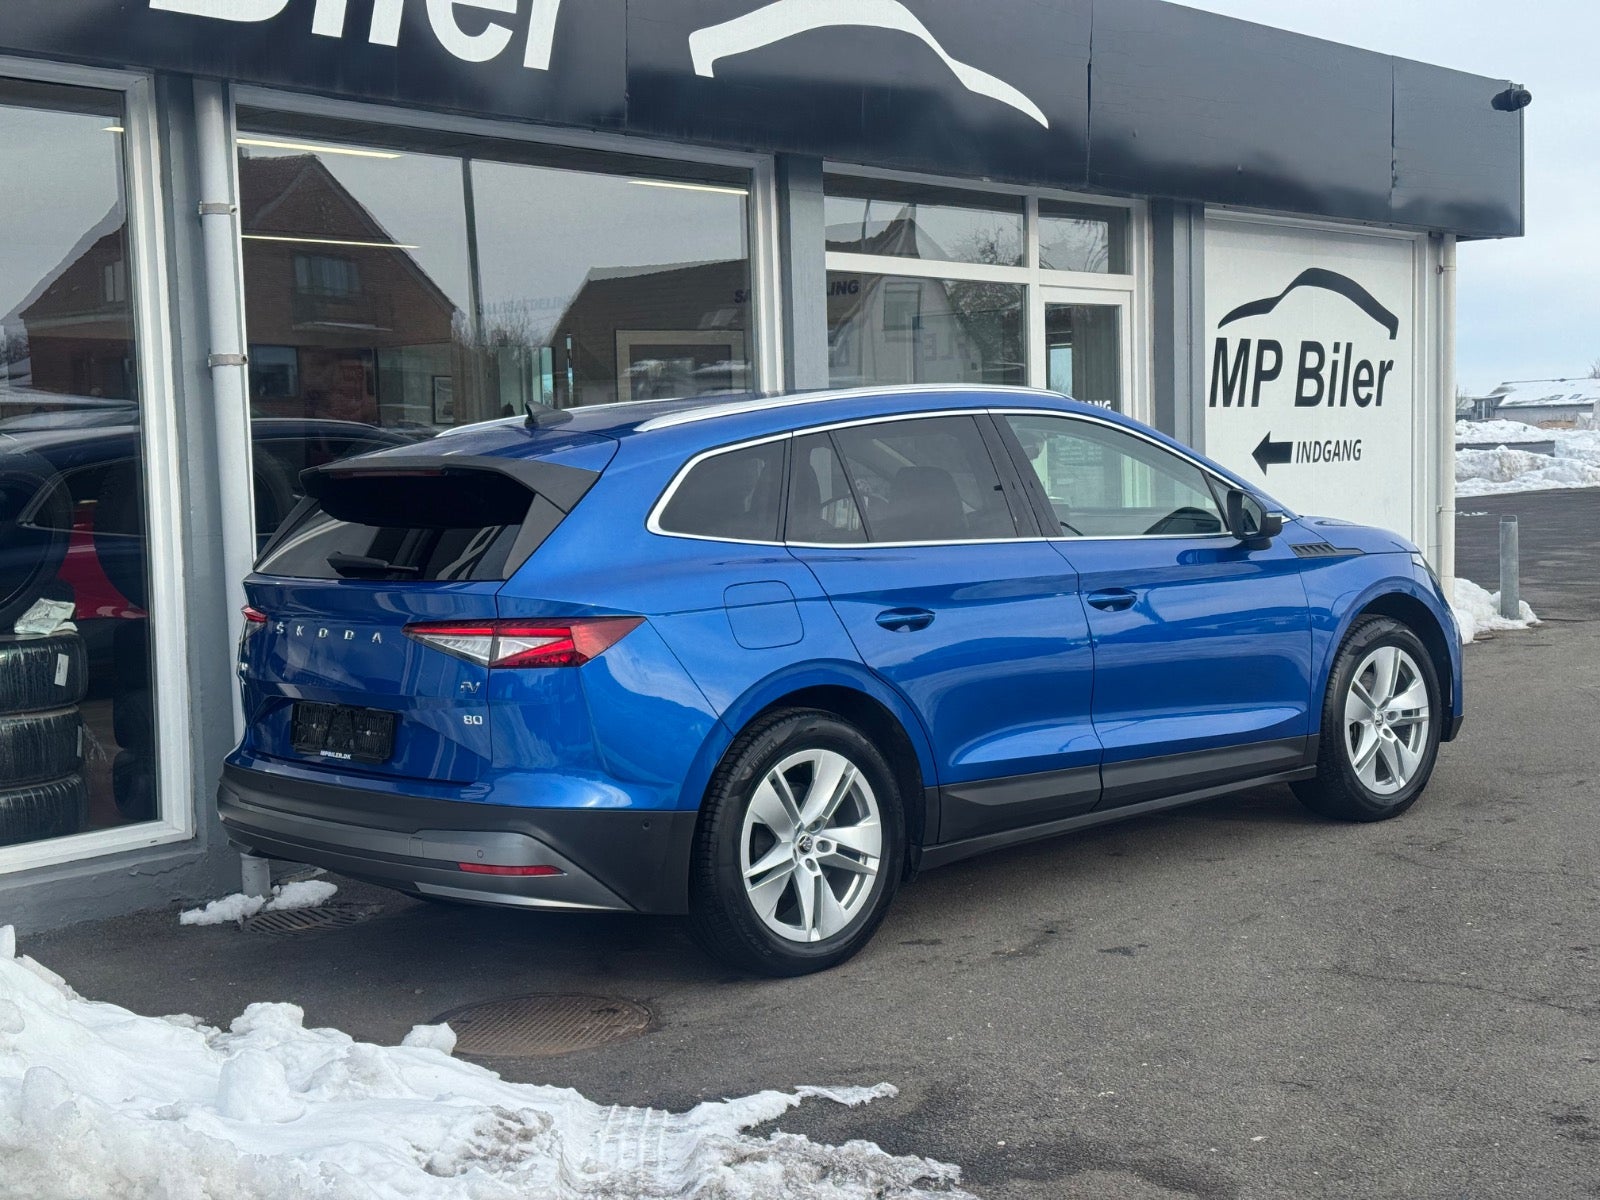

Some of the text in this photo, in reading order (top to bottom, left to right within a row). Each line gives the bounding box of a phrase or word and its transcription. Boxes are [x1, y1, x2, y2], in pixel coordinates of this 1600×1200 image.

[1209, 337, 1394, 408] MP Biler
[1296, 439, 1362, 464] INDGANG
[463, 714, 483, 725] 80
